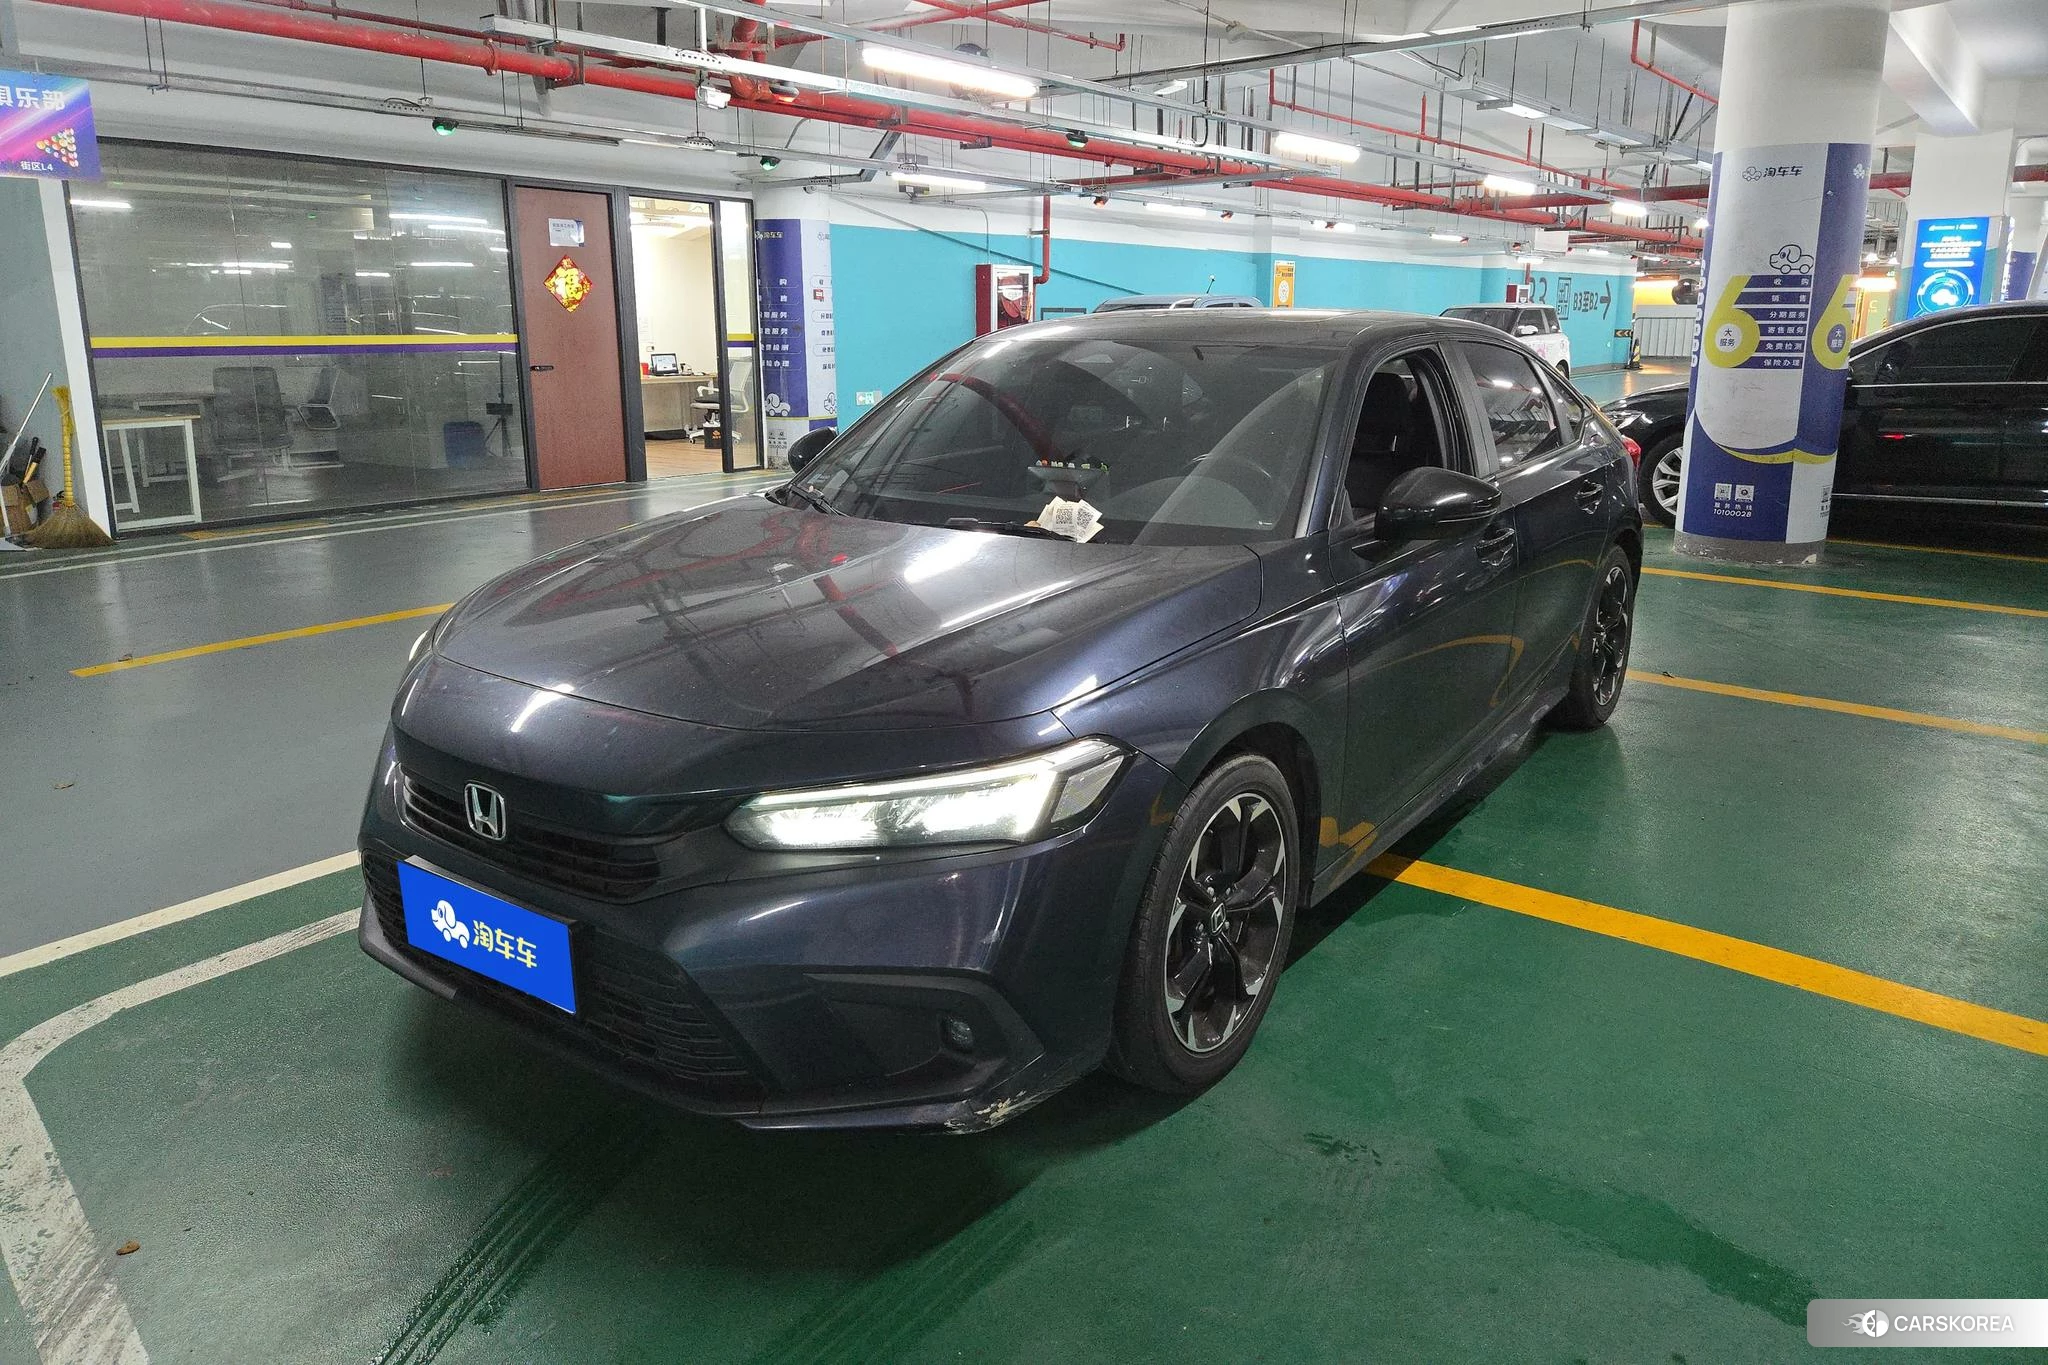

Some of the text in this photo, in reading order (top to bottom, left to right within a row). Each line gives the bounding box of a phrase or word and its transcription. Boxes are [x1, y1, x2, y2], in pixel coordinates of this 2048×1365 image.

[1763, 166, 1803, 178] 淘车车
[554, 266, 584, 301] 福
[1573, 291, 1599, 312] B3至B2
[1769, 311, 1806, 319] 分期服务
[1704, 274, 1760, 368] 6
[1724, 328, 1732, 337] 大
[1835, 329, 1842, 337] 大
[1719, 338, 1736, 347] 服务
[1766, 342, 1802, 350] 免费检测
[1713, 508, 1752, 518] 10100028
